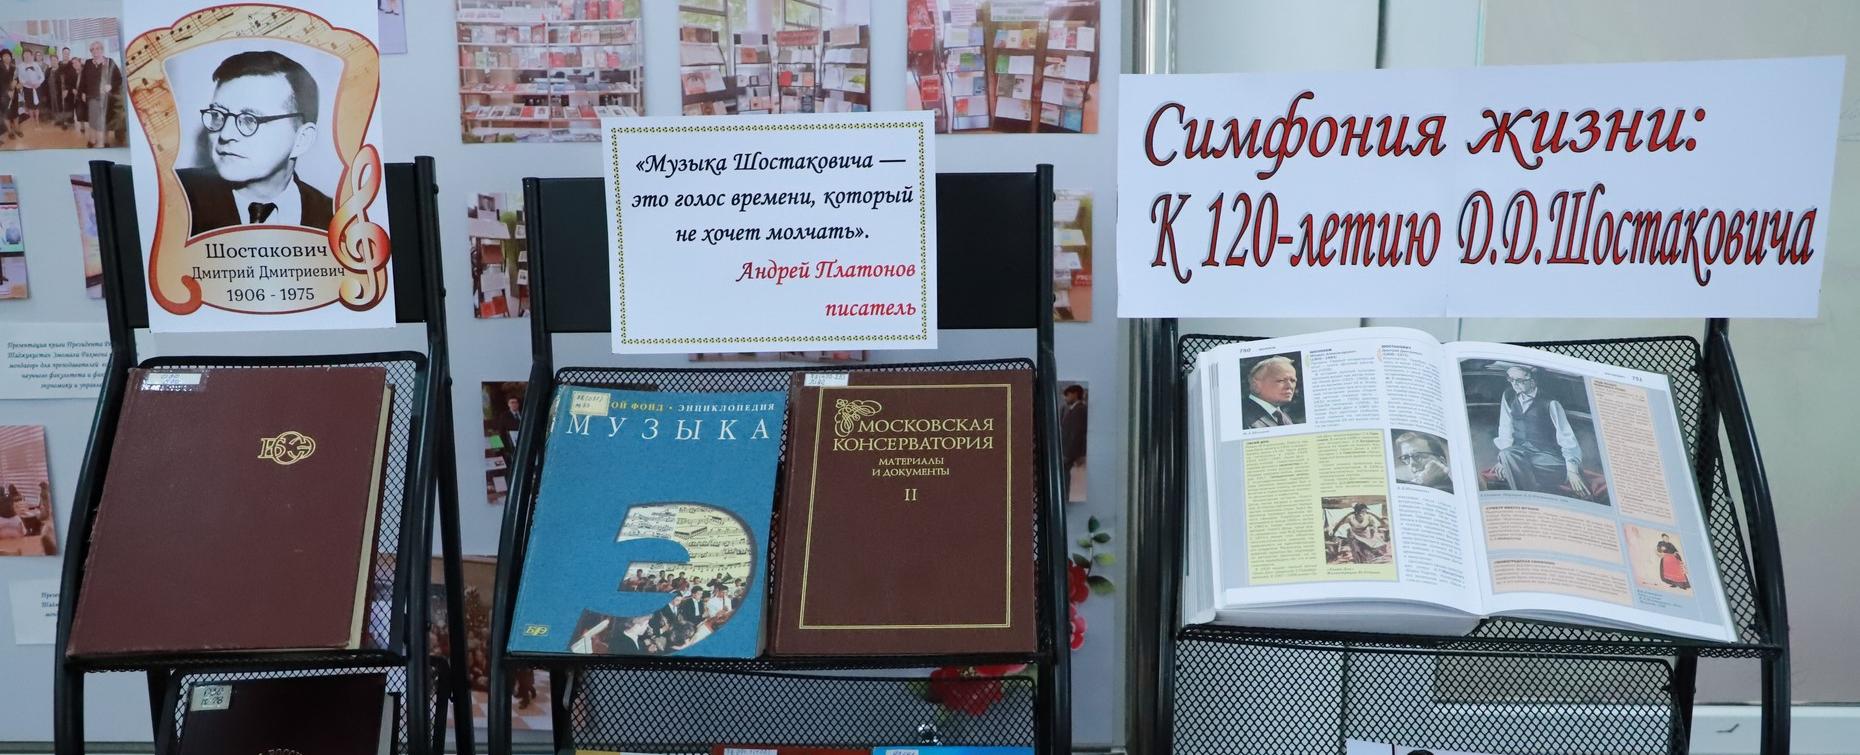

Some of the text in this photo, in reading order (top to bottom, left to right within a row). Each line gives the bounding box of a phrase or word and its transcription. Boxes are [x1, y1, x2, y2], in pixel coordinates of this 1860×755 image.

[1145, 91, 1706, 181] Симфония жизни:
[635, 152, 727, 178] «Музыка
[733, 152, 874, 174] Шостаковича
[632, 186, 914, 212] это голос времени, который
[676, 226, 870, 245] не хочет молчать».
[1151, 193, 1192, 285] К
[1202, 191, 1442, 268] 120-летию
[205, 243, 328, 259] Шостакович
[192, 265, 345, 282] Дмитрий Дмитриевич
[736, 259, 916, 285] Андрей Платонов
[226, 288, 265, 302] 1906
[280, 287, 315, 301] 1975
[825, 301, 917, 318] писатель
[630, 402, 665, 412] ФОНД
[677, 403, 776, 412] ЭНЦИКЛОПЕДИЯ
[566, 411, 770, 440] МУЗЫКА
[857, 418, 994, 433] МОСКОВСКАЯ
[832, 437, 994, 452] КОНСЕРВАТОРИЯ
[878, 457, 944, 466] МАТЕРИАЛЫ
[882, 467, 950, 476] ДОКУМЕНТЫ
[904, 488, 918, 501] II
